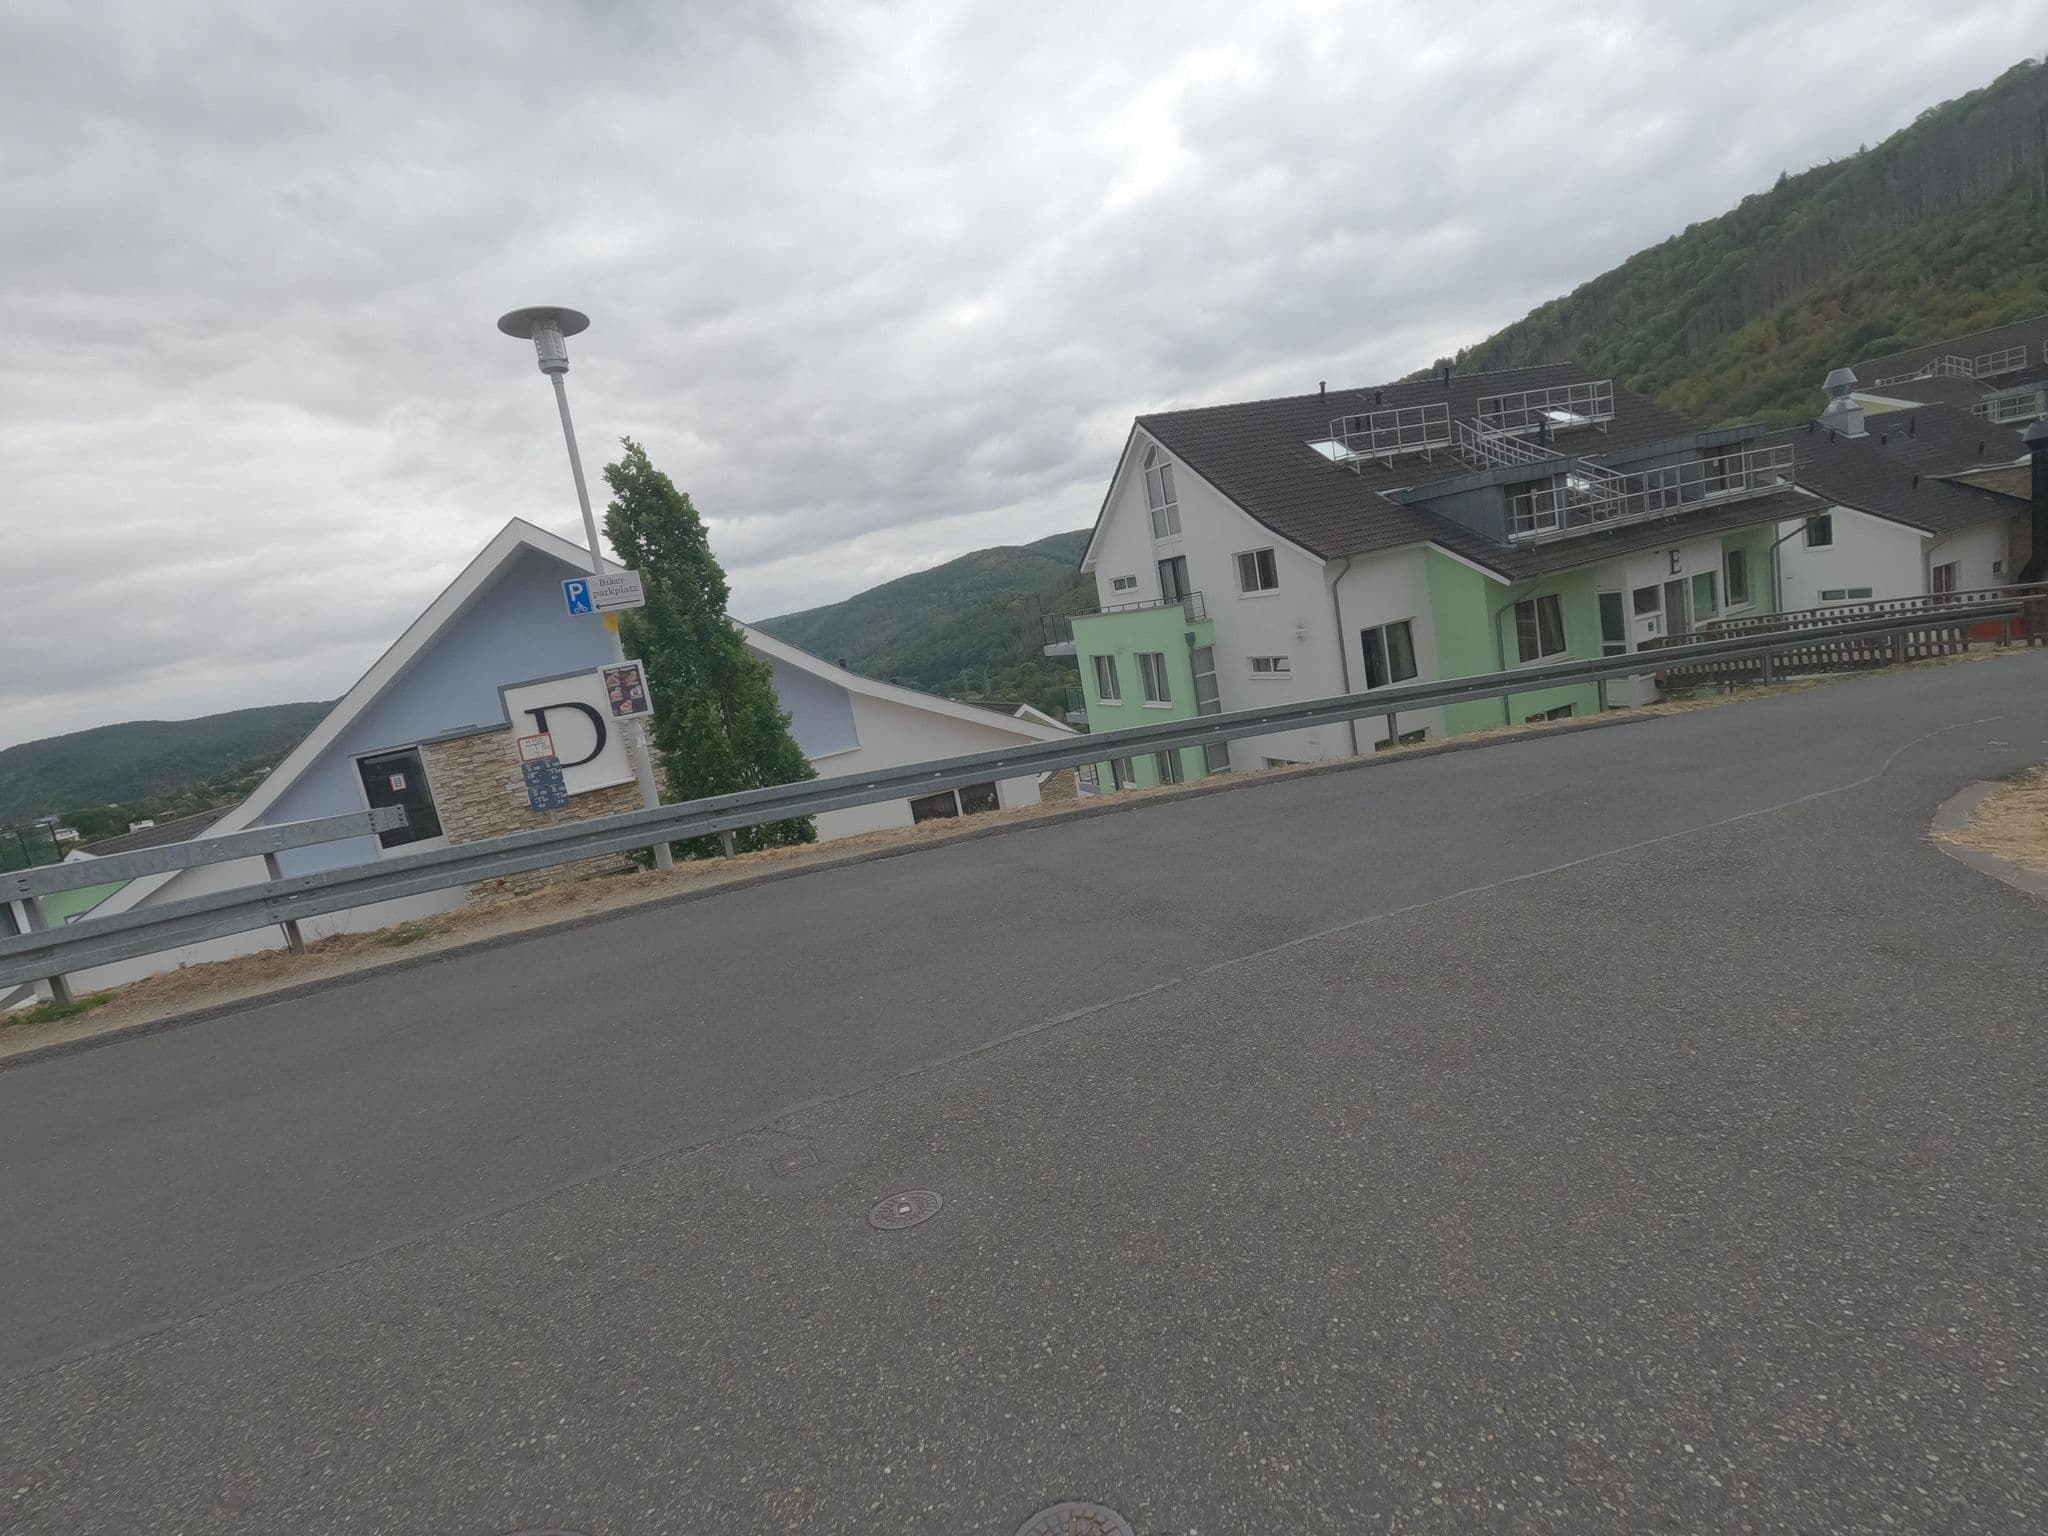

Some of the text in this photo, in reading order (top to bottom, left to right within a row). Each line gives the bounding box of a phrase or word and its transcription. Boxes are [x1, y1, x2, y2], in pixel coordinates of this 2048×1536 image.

[1669, 549, 1682, 575] E
[568, 583, 583, 602] P
[593, 584, 640, 599] parkplatz
[524, 702, 607, 768] D
